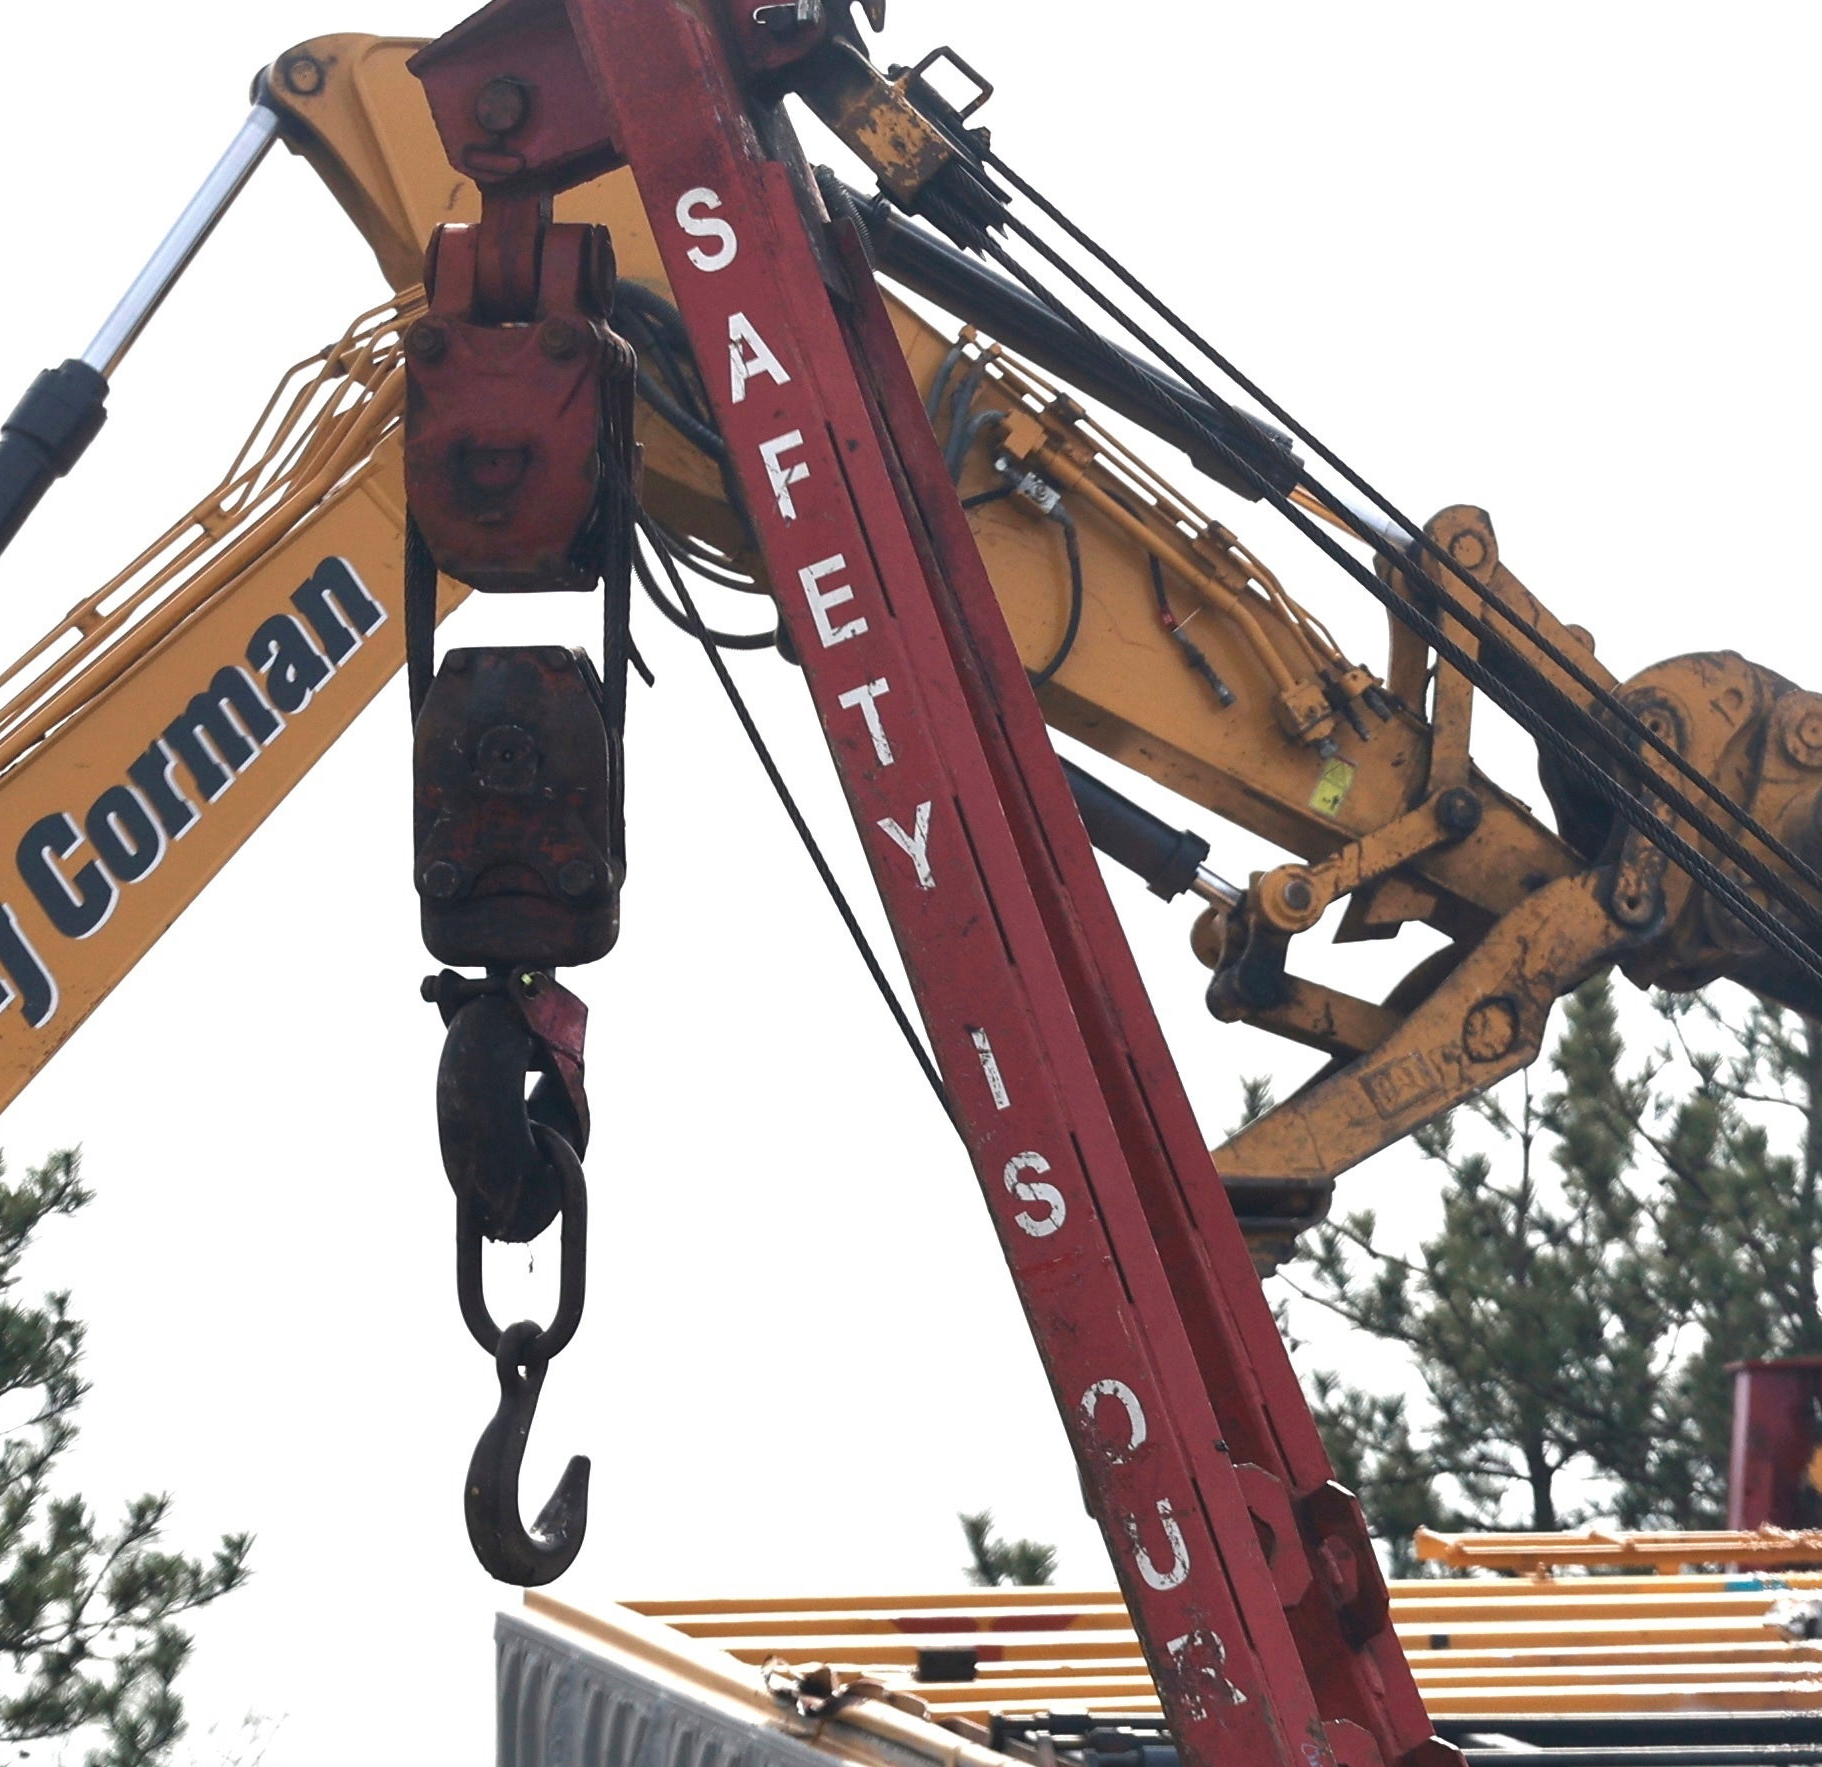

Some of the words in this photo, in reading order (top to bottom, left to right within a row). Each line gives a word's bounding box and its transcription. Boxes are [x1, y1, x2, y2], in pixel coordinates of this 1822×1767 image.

[16, 556, 388, 939] Corman
[675, 187, 931, 888] SAFETY
[972, 1027, 1067, 1237] IS
